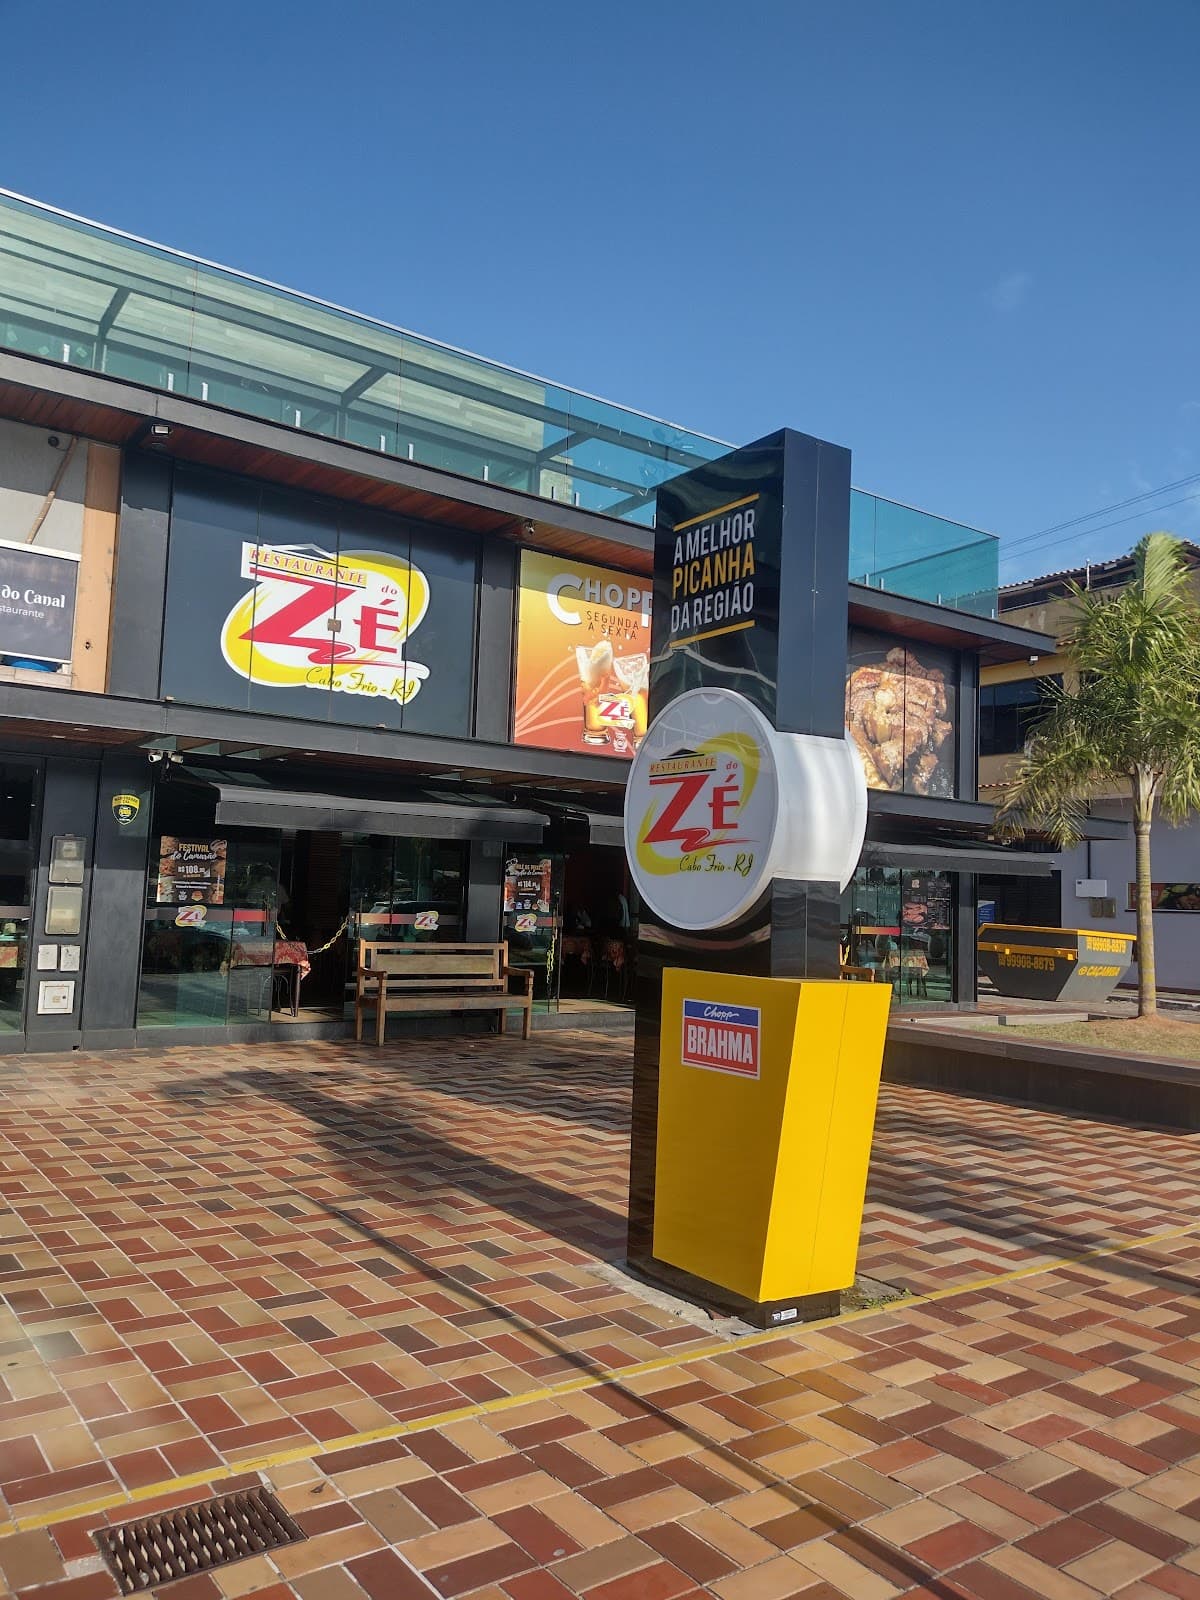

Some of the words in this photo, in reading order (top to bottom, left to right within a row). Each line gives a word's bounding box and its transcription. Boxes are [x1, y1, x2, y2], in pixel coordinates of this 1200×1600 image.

[673, 535, 684, 566] A
[686, 508, 755, 561] MELHOR
[249, 548, 367, 585] RESTAURANTE
[672, 541, 756, 601] PICANHA
[1, 584, 21, 601] do
[24, 589, 66, 609] Canal
[381, 583, 398, 596] do
[238, 567, 401, 665] ZÉ
[671, 601, 691, 634] DA
[693, 580, 755, 630] REGIÃO
[586, 610, 640, 631] SEGUNDA
[587, 622, 595, 632] A
[601, 623, 638, 641] SEXTA
[305, 666, 342, 688] Cabo
[346, 672, 379, 693] Frio
[389, 677, 416, 701] RJ
[650, 755, 717, 772] RESTAURANTE
[726, 760, 738, 771] do
[642, 774, 741, 852] ZÉ
[179, 843, 210, 853] FESTIVAL
[679, 854, 702, 873] Cabo
[704, 854, 726, 873] Frio
[733, 854, 754, 878] RJ
[703, 1006, 739, 1021] Chopp
[687, 1024, 753, 1065] BRAHMA
